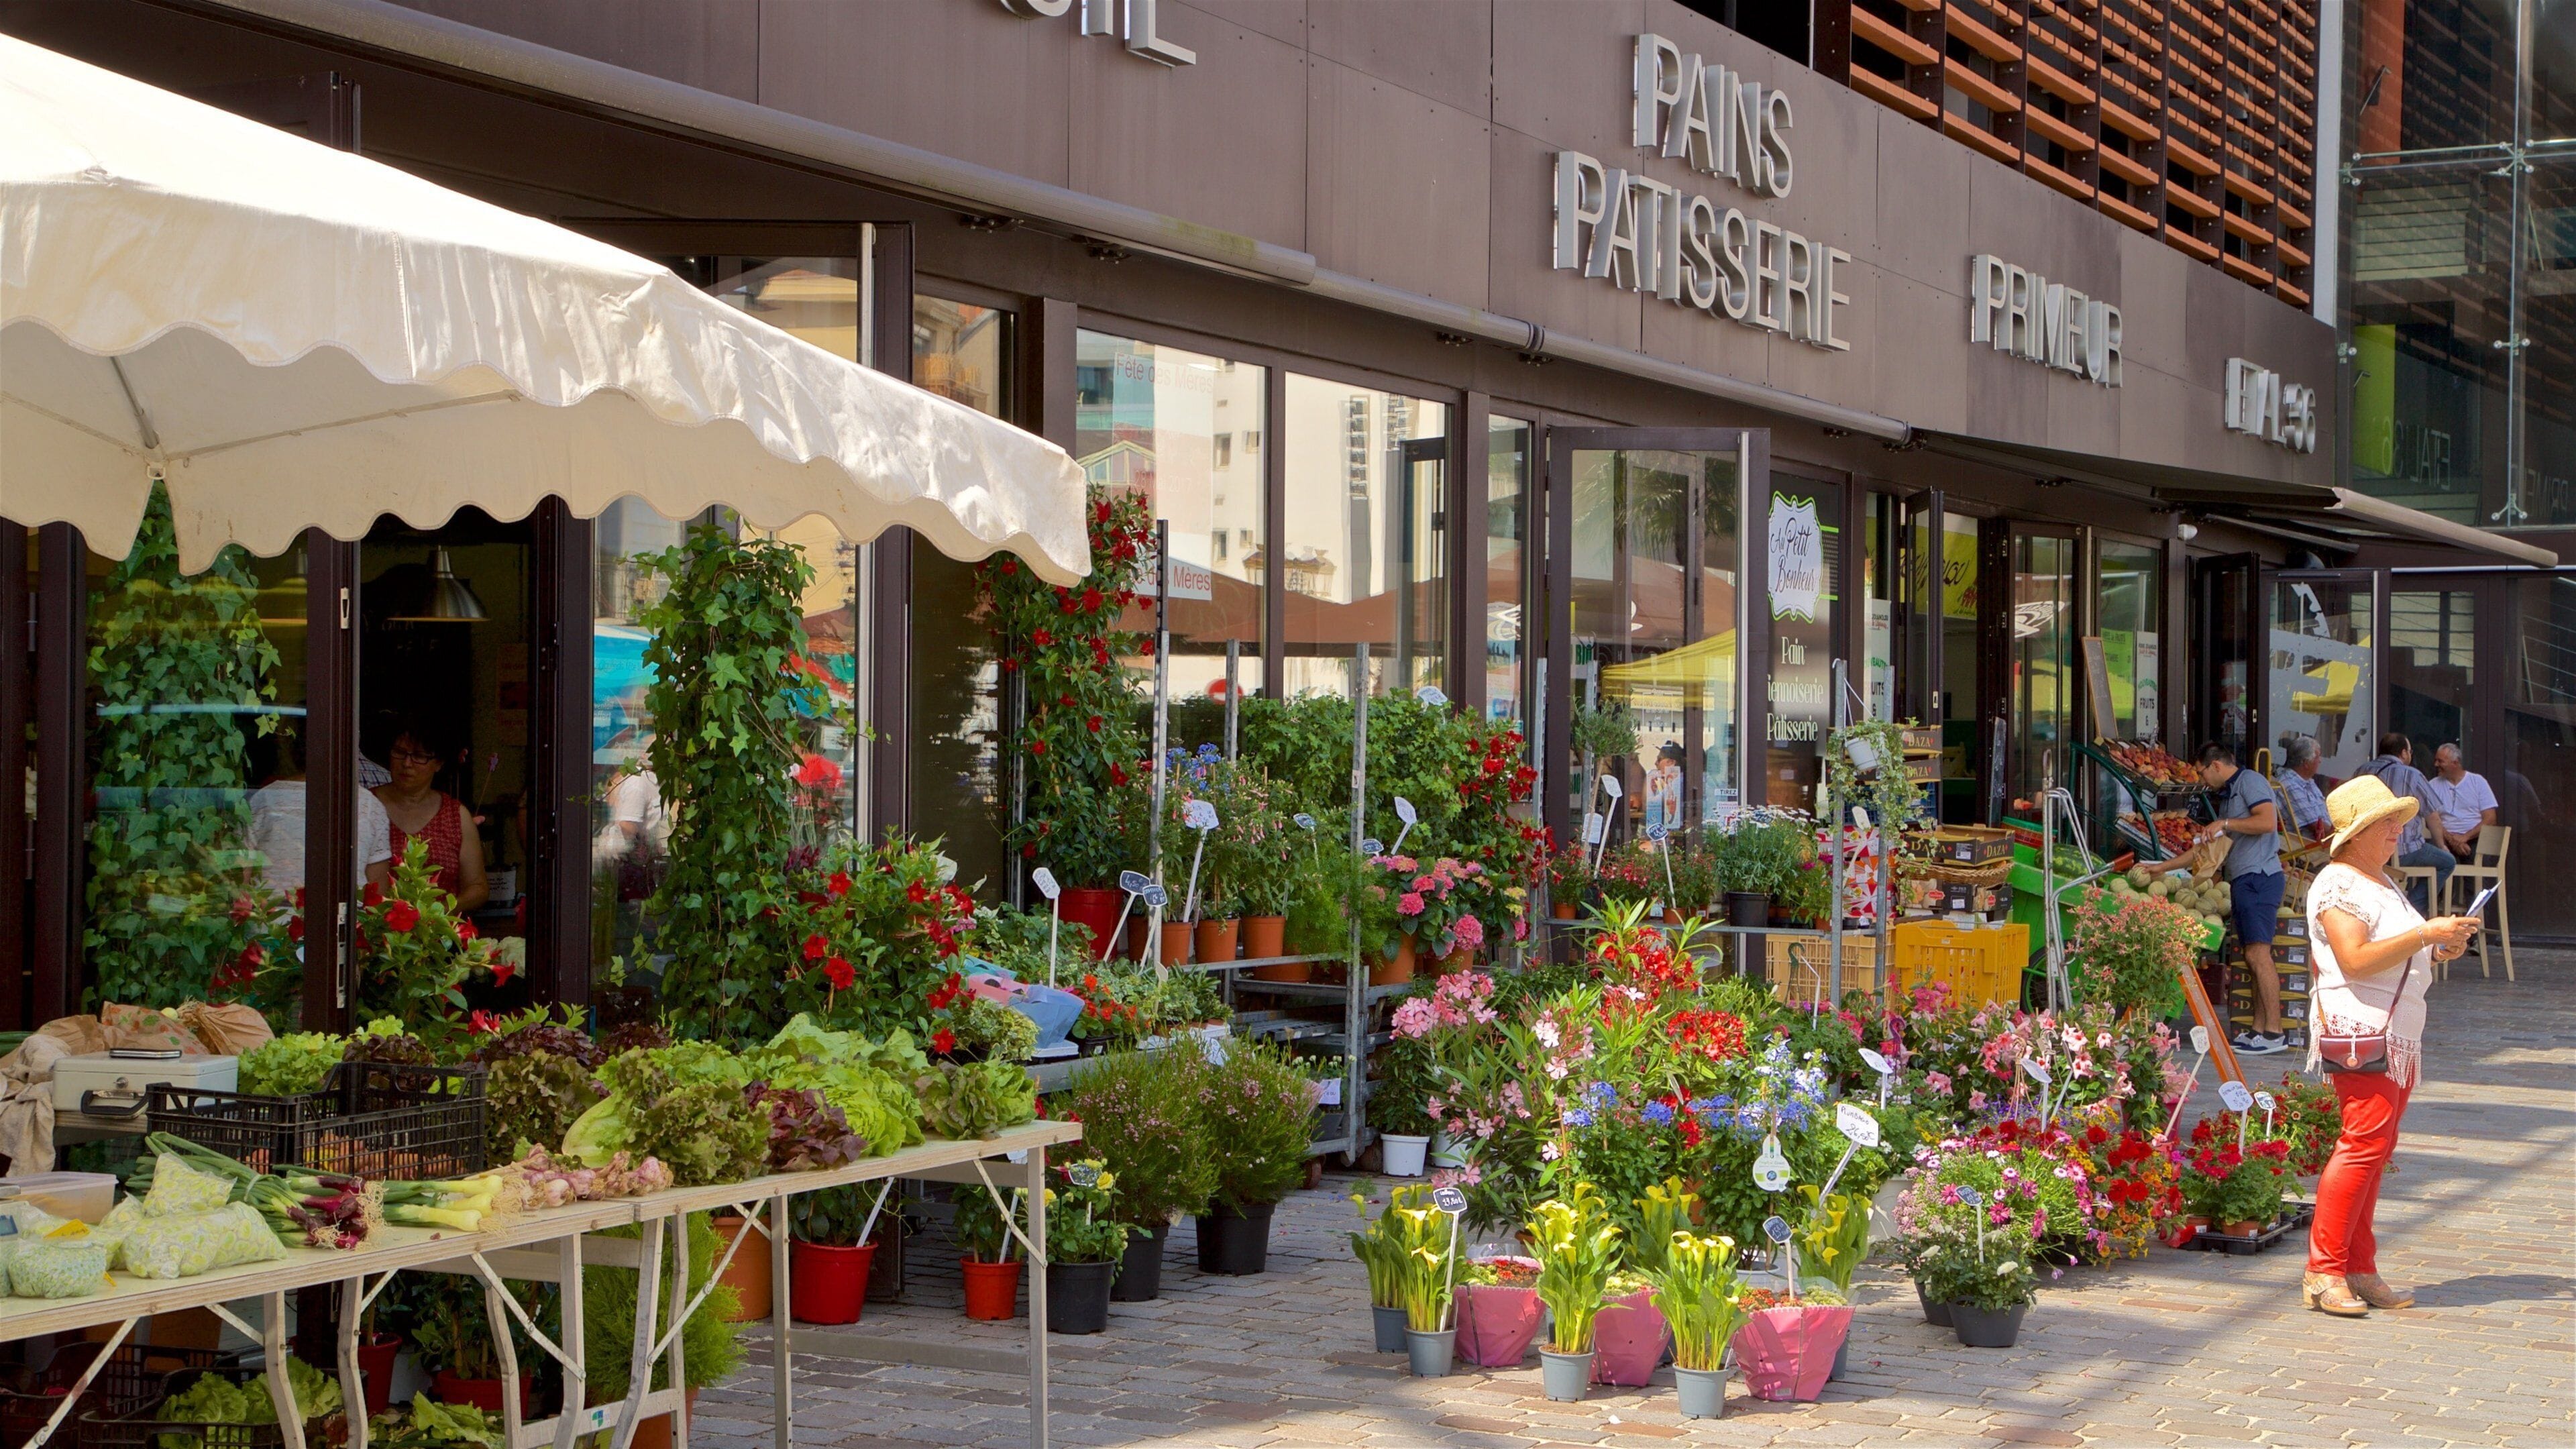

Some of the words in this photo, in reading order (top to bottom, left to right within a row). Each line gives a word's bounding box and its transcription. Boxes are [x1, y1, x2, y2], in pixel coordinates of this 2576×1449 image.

[1633, 33, 1793, 199] PAINS
[1553, 150, 1851, 352] PATISSERIE
[1971, 254, 2123, 388] PRIMEUR
[1116, 354, 1144, 380] Fête
[1148, 360, 1171, 386] des
[1770, 527, 1785, 554] Au
[1785, 517, 1813, 559] Petit
[1173, 566, 1210, 591] Mères
[1775, 554, 1815, 593] Bonheur
[1781, 636, 1806, 665] Pain
[1766, 674, 1825, 704] iennoiserie
[2139, 698, 2155, 709] FRUITS
[1766, 712, 1819, 741] Pâtisserie
[1909, 733, 1931, 747] DAZA
[1986, 844, 2006, 858] DAZA
